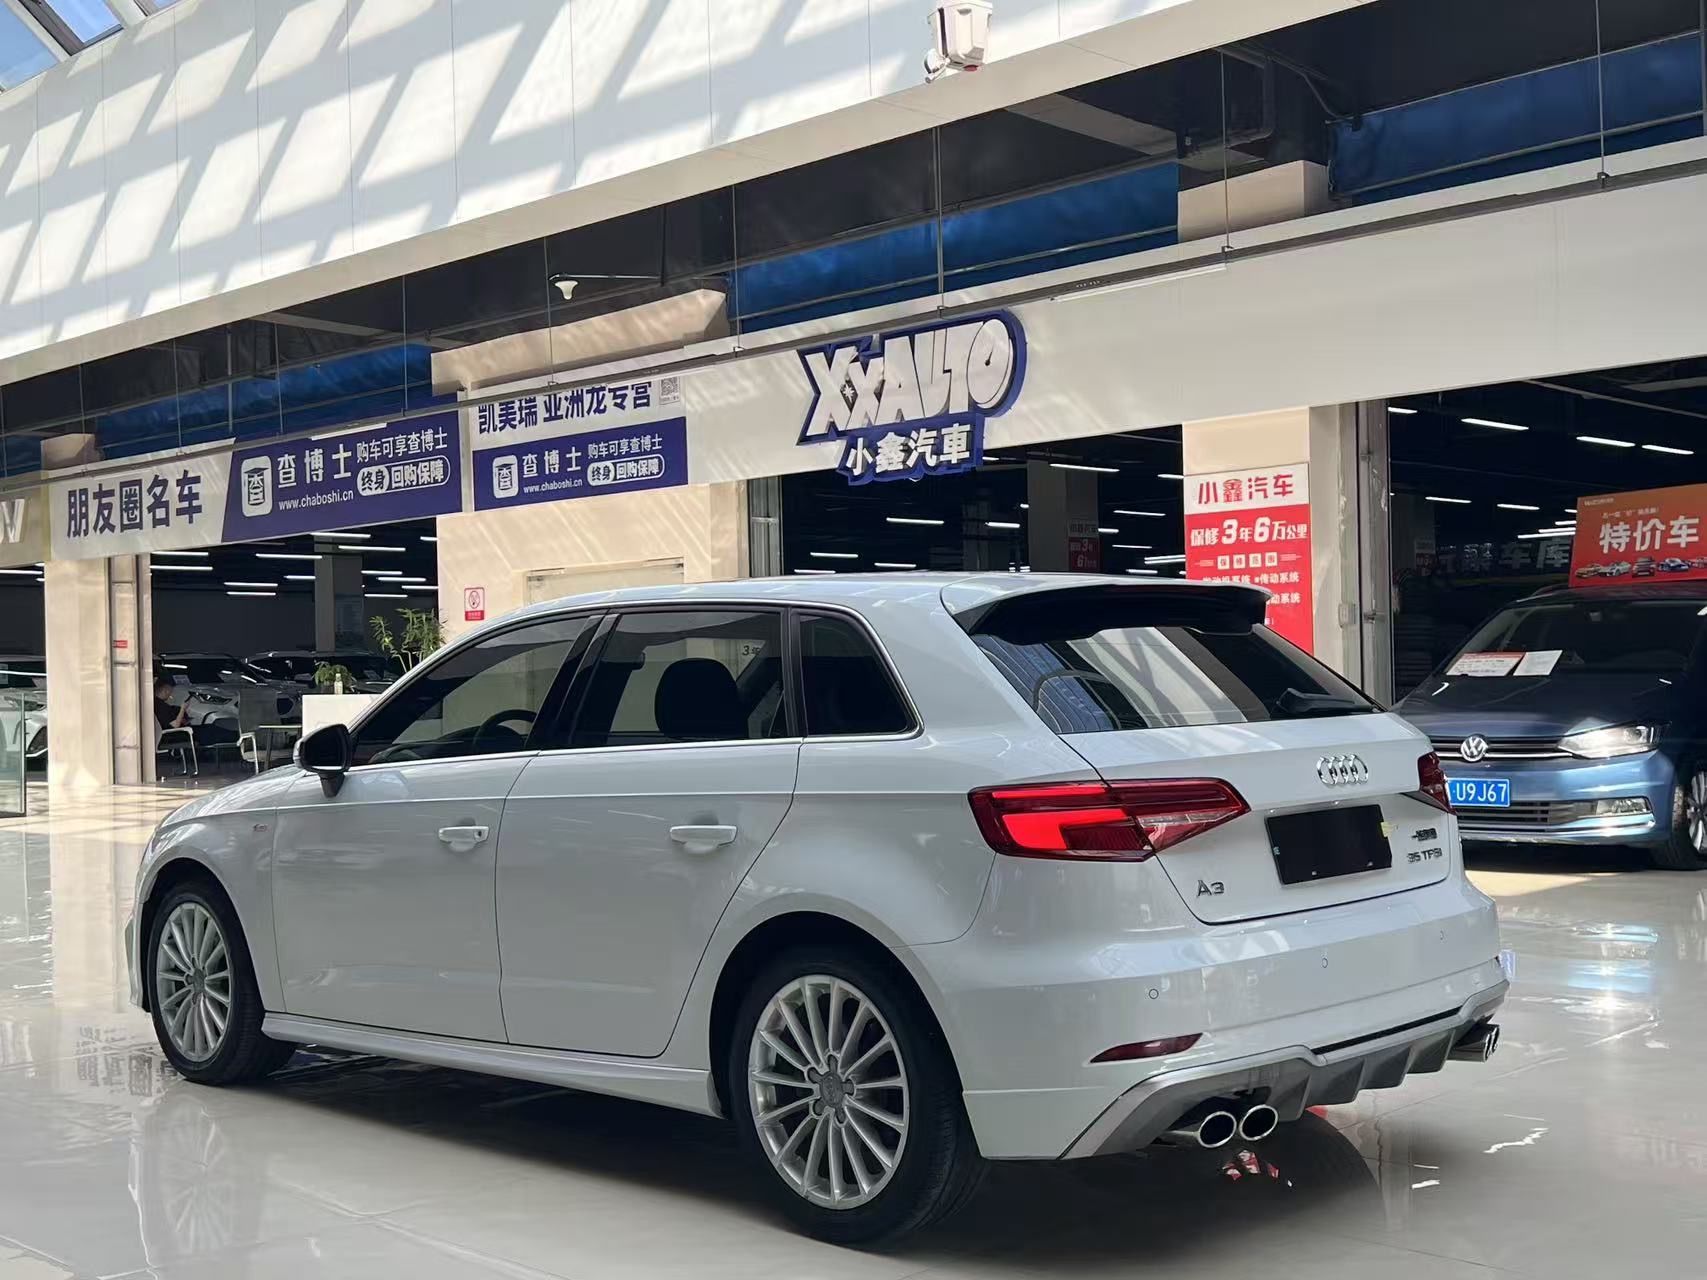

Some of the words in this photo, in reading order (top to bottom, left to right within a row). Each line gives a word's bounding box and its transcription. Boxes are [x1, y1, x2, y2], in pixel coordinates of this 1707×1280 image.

[356, 427, 448, 464] 购车可享查博士
[588, 434, 663, 459] 购车可享查博士
[846, 423, 971, 476] 小鑫汽車
[277, 444, 352, 488] 查博士
[361, 468, 387, 492] 终身
[391, 459, 445, 489] 回购保障
[522, 446, 583, 478] 查博士
[591, 465, 612, 481] 终身
[616, 458, 660, 480] 回购保障
[278, 489, 354, 510] www.chaboshi.cn
[523, 478, 583, 494] www.chaboshi.cn
[1198, 474, 1294, 504] 小鑫汽车
[67, 469, 202, 538] 朋友圈名车
[1599, 515, 1700, 554] 特价车
[1266, 593, 1301, 605] 动系统
[1197, 879, 1225, 897] A3
